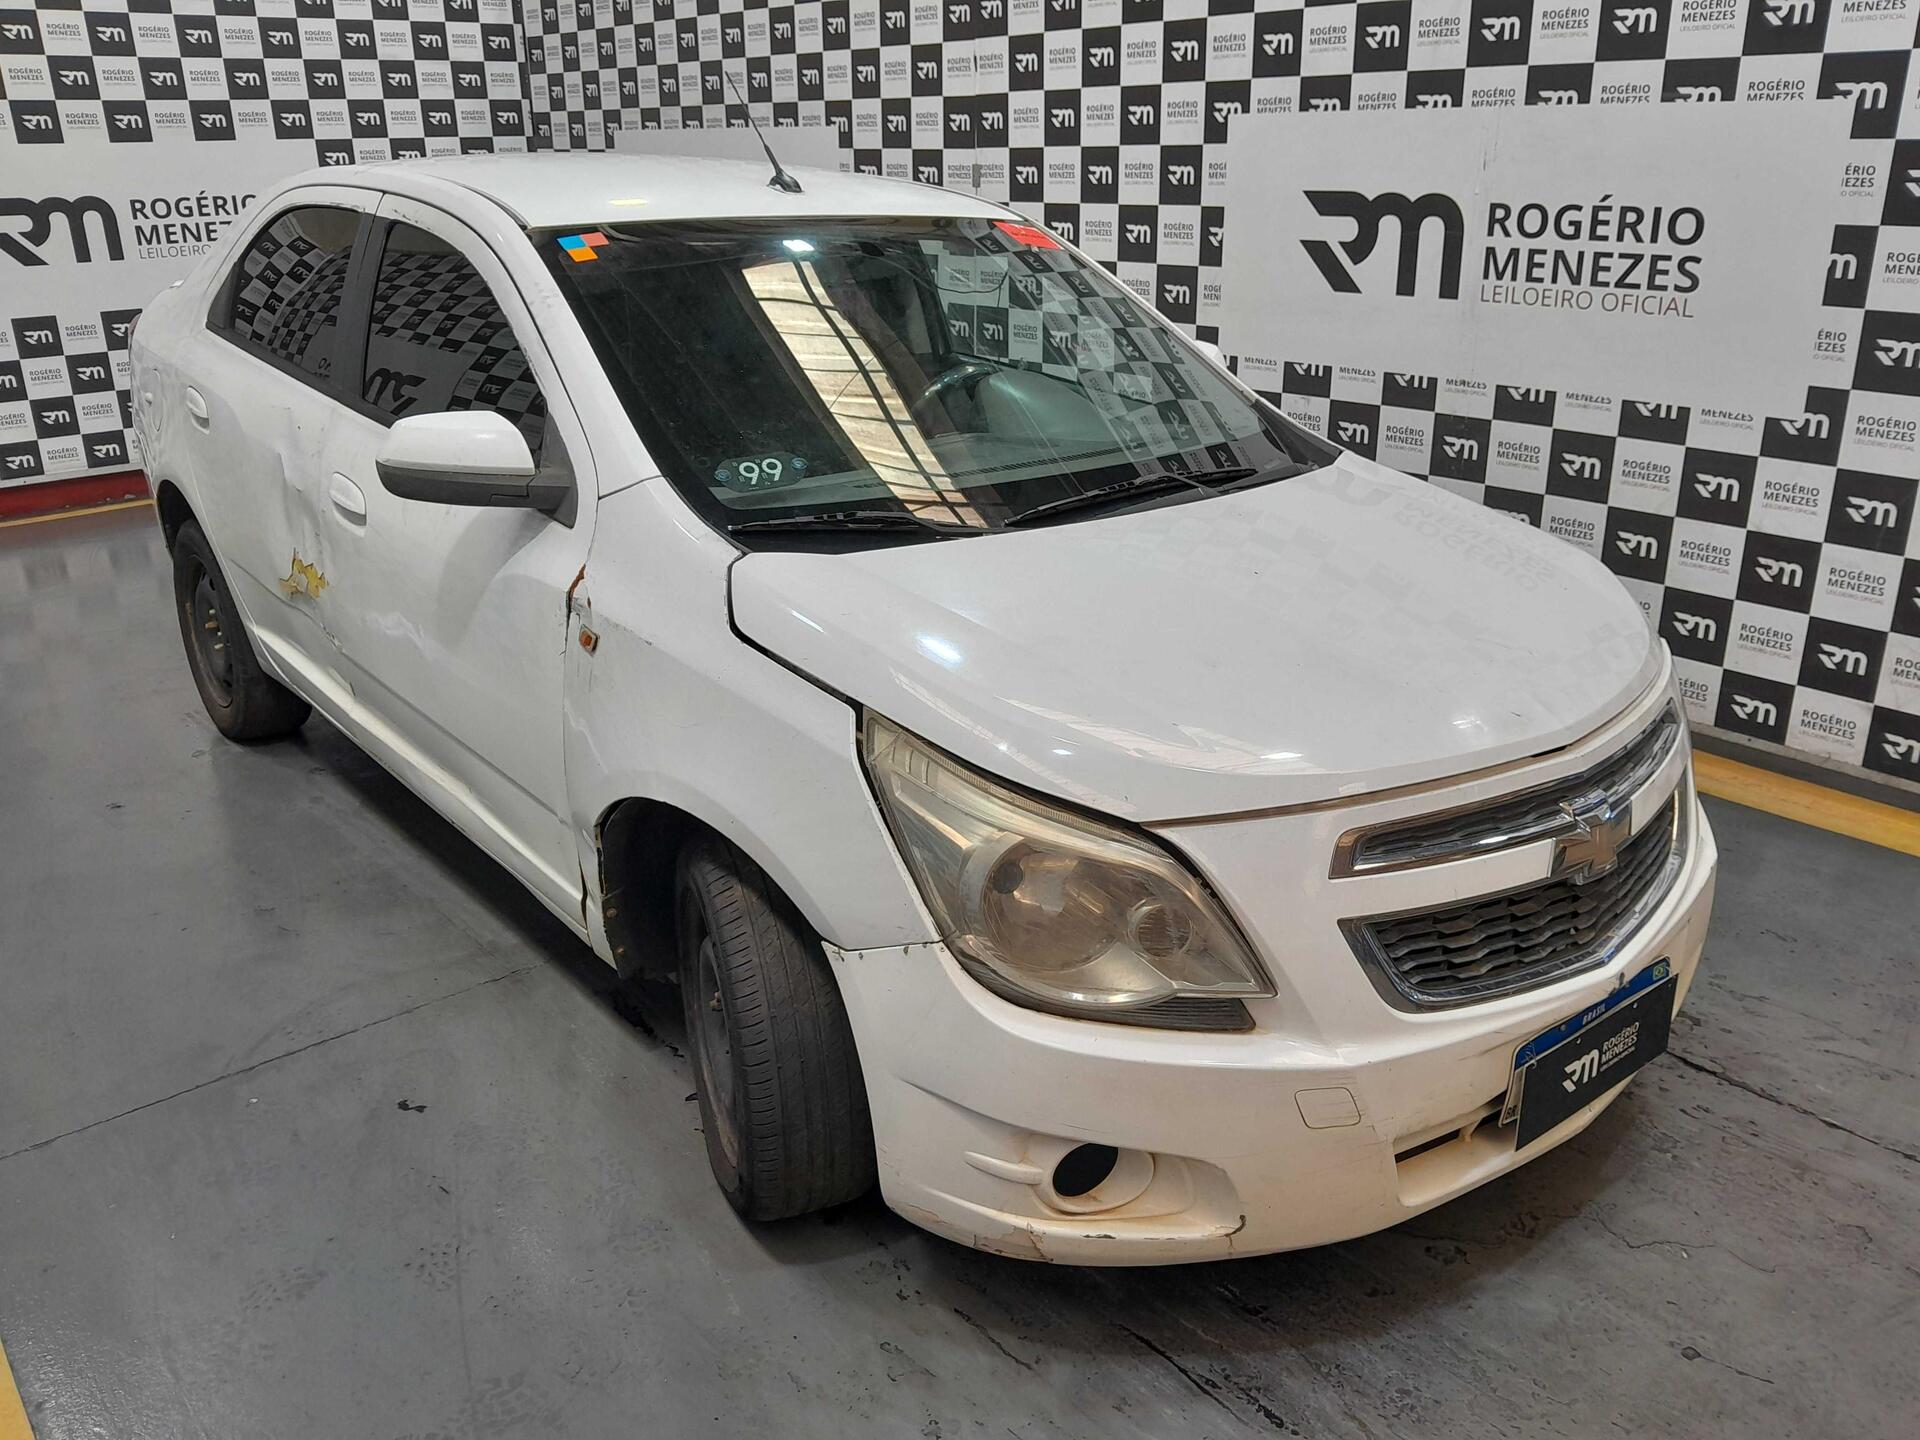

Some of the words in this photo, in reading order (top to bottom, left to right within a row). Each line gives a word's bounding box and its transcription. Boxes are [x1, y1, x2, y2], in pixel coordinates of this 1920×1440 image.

[1542, 7, 1589, 20] ROGÉRIO
[1681, 10, 1736, 22] MENEZES
[1419, 16, 1460, 28] ROGÉRIO
[1541, 19, 1588, 30] MENEZES
[1310, 25, 1347, 36] ROGÉRIO
[1418, 27, 1460, 38] MENEZES
[1213, 34, 1246, 44] ROGÉRIO
[1310, 35, 1346, 46] MENEZES
[1127, 41, 1156, 50] ROGÉRIO
[1213, 43, 1246, 52] MENEZES
[1050, 48, 1076, 56] ROGÉRIO
[1127, 50, 1156, 58] MENEZES
[1049, 56, 1076, 64] MENEZES
[1601, 82, 1650, 95] ROGÉRIO
[1748, 78, 1805, 91] ROGÉRIO
[1358, 92, 1397, 103] ROGÉRIO
[1472, 87, 1516, 98] ROGÉRIO
[1167, 100, 1198, 109] ROGÉRIO
[1257, 96, 1292, 106] ROGÉRIO
[1086, 104, 1114, 112] ROGÉRIO
[1167, 110, 1198, 118] MENEZES
[1086, 112, 1114, 120] MENEZES
[1049, 163, 1075, 171] ROGÉRIO
[1125, 162, 1153, 170] ROGÉRIO
[1841, 177, 1875, 188] EZES
[1085, 220, 1112, 228] ROGÉRIO
[1486, 194, 1706, 246] ROGÉRIO
[1085, 228, 1112, 236] MENEZES
[1164, 222, 1194, 231] ROGÉRIO
[1164, 232, 1194, 240] MENEZES
[1482, 246, 1703, 294] MENEZES
[1480, 285, 1594, 311] LEILOEIRO
[1600, 292, 1695, 319] OFICIAL
[1857, 416, 1916, 431] ROGÉRIO
[1386, 425, 1424, 437] ROGÉRIO
[1856, 426, 1915, 442] MENEZES
[1386, 434, 1424, 446] MENEZES
[1498, 441, 1540, 454] ROGÉRIO
[1497, 450, 1540, 464] MENEZES
[1623, 460, 1671, 474] ROGÉRIO
[1622, 469, 1670, 484] MENEZES
[1765, 481, 1820, 497] ROGÉRIO
[1763, 491, 1818, 508] MENEZES
[1550, 516, 1595, 531] ROGÉRIO
[1549, 525, 1594, 540] MENEZES
[1681, 540, 1731, 556] ROGÉRIO
[1679, 550, 1730, 566] MENEZES
[1830, 567, 1886, 586] ROGÉRIO
[1828, 578, 1884, 596] MENEZES
[1740, 624, 1793, 642] ROGÉRIO
[1739, 633, 1792, 652] MENEZES
[1802, 710, 1856, 730] ROGÉRIO
[1800, 718, 1855, 740] MENEZES
[1583, 1004, 1606, 1025] BRASIL
[1602, 1022, 1640, 1051] ROGÉRIO
[1601, 1034, 1638, 1064] MENEZES
